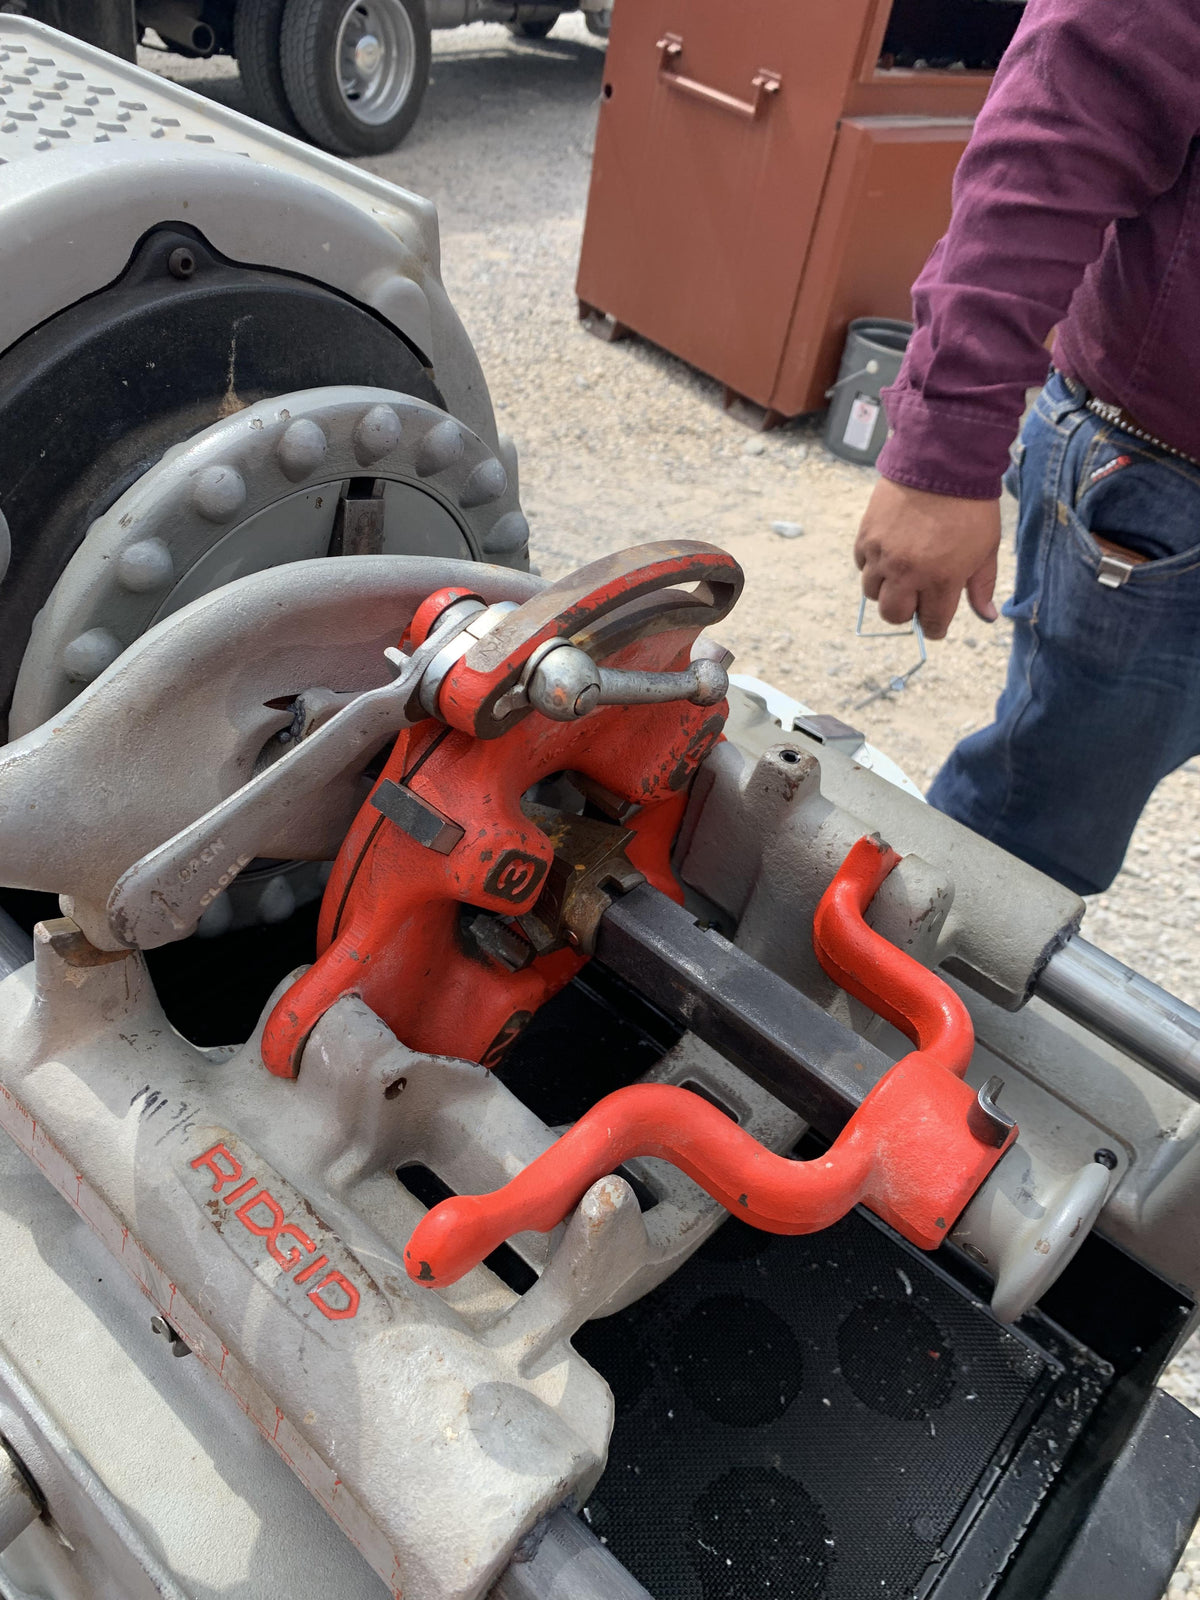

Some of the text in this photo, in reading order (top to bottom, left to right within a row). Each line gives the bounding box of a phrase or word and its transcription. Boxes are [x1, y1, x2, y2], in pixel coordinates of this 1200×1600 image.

[178, 838, 226, 884] OPEN
[200, 853, 251, 906] CLOSE
[496, 858, 536, 897] 3
[190, 1142, 361, 1321] RIDGID
